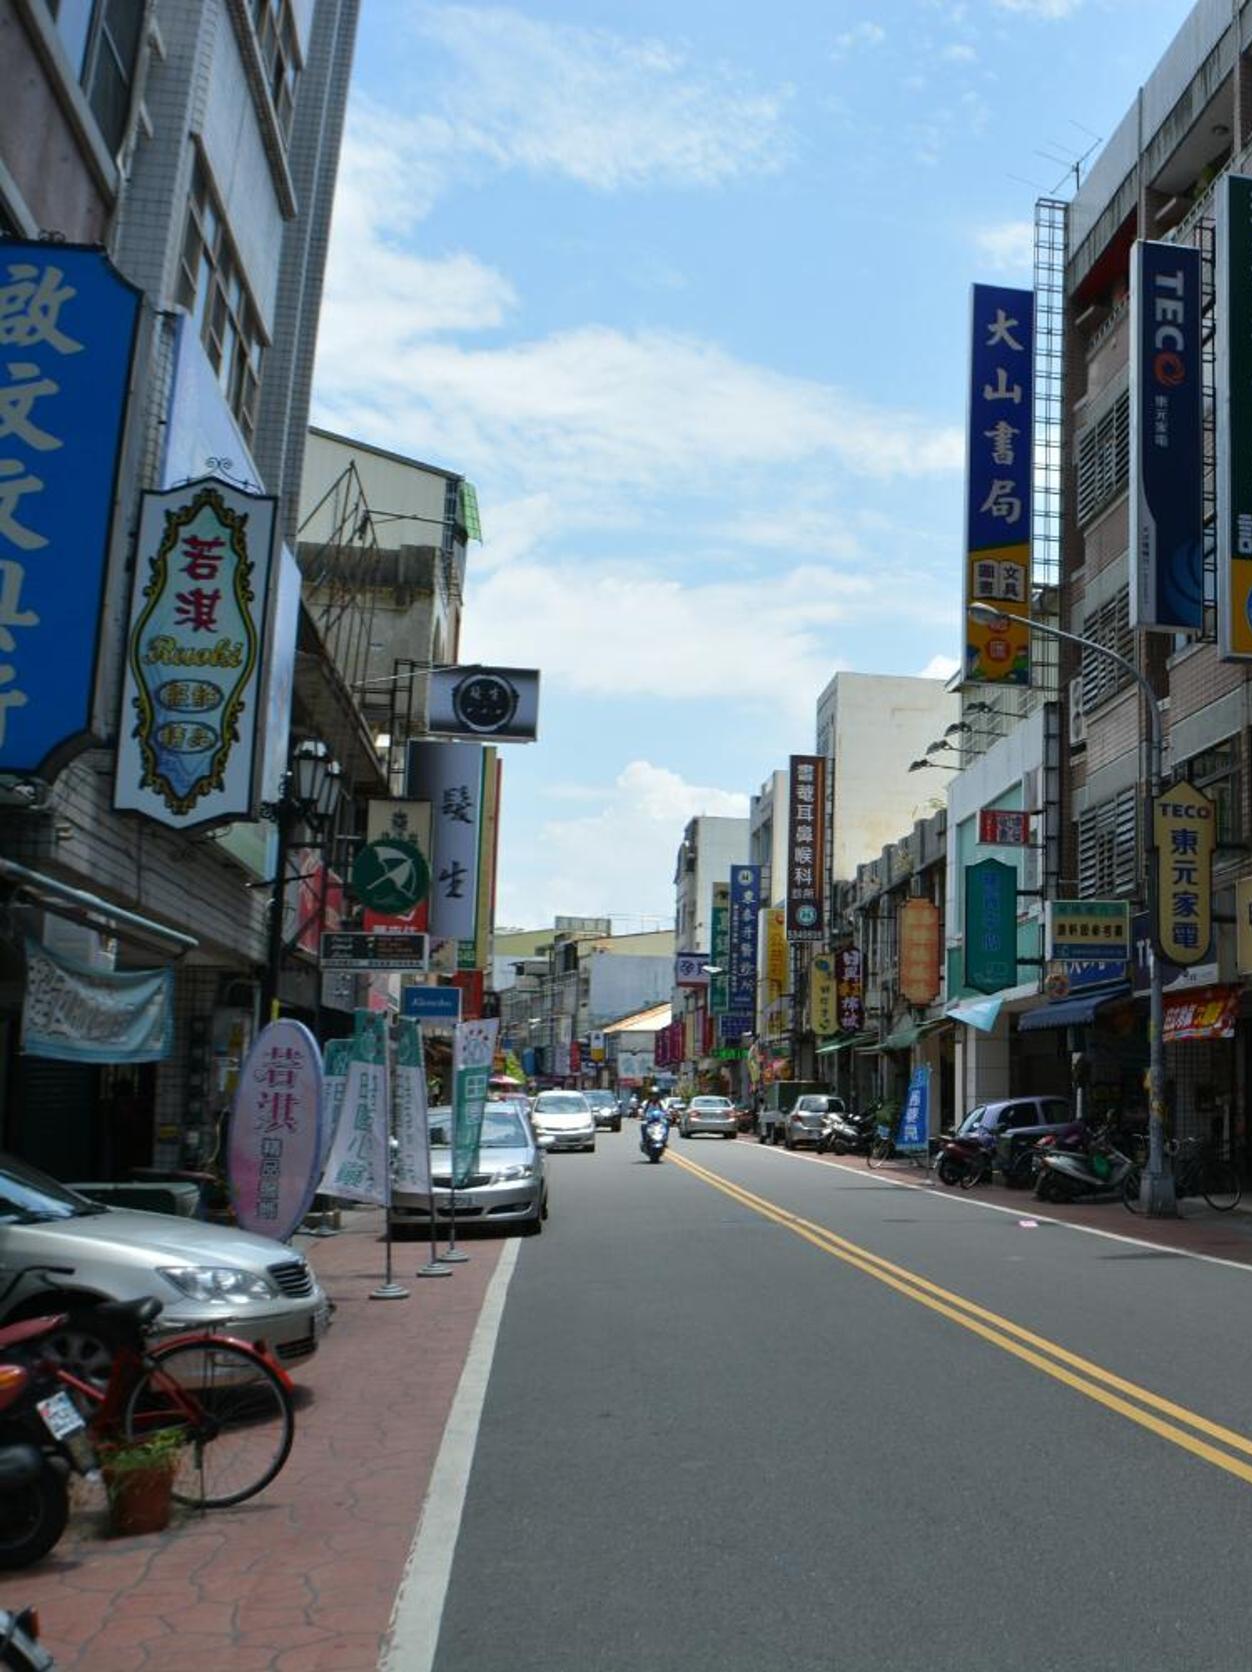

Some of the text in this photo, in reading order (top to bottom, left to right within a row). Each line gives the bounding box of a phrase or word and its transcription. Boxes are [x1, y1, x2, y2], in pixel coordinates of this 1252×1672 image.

[1154, 268, 1185, 386] TECO
[979, 308, 1024, 525] 大山書局
[794, 763, 815, 886] 耳鼻喉科
[1159, 802, 1211, 820] TECO
[1171, 828, 1199, 949] 東元家電
